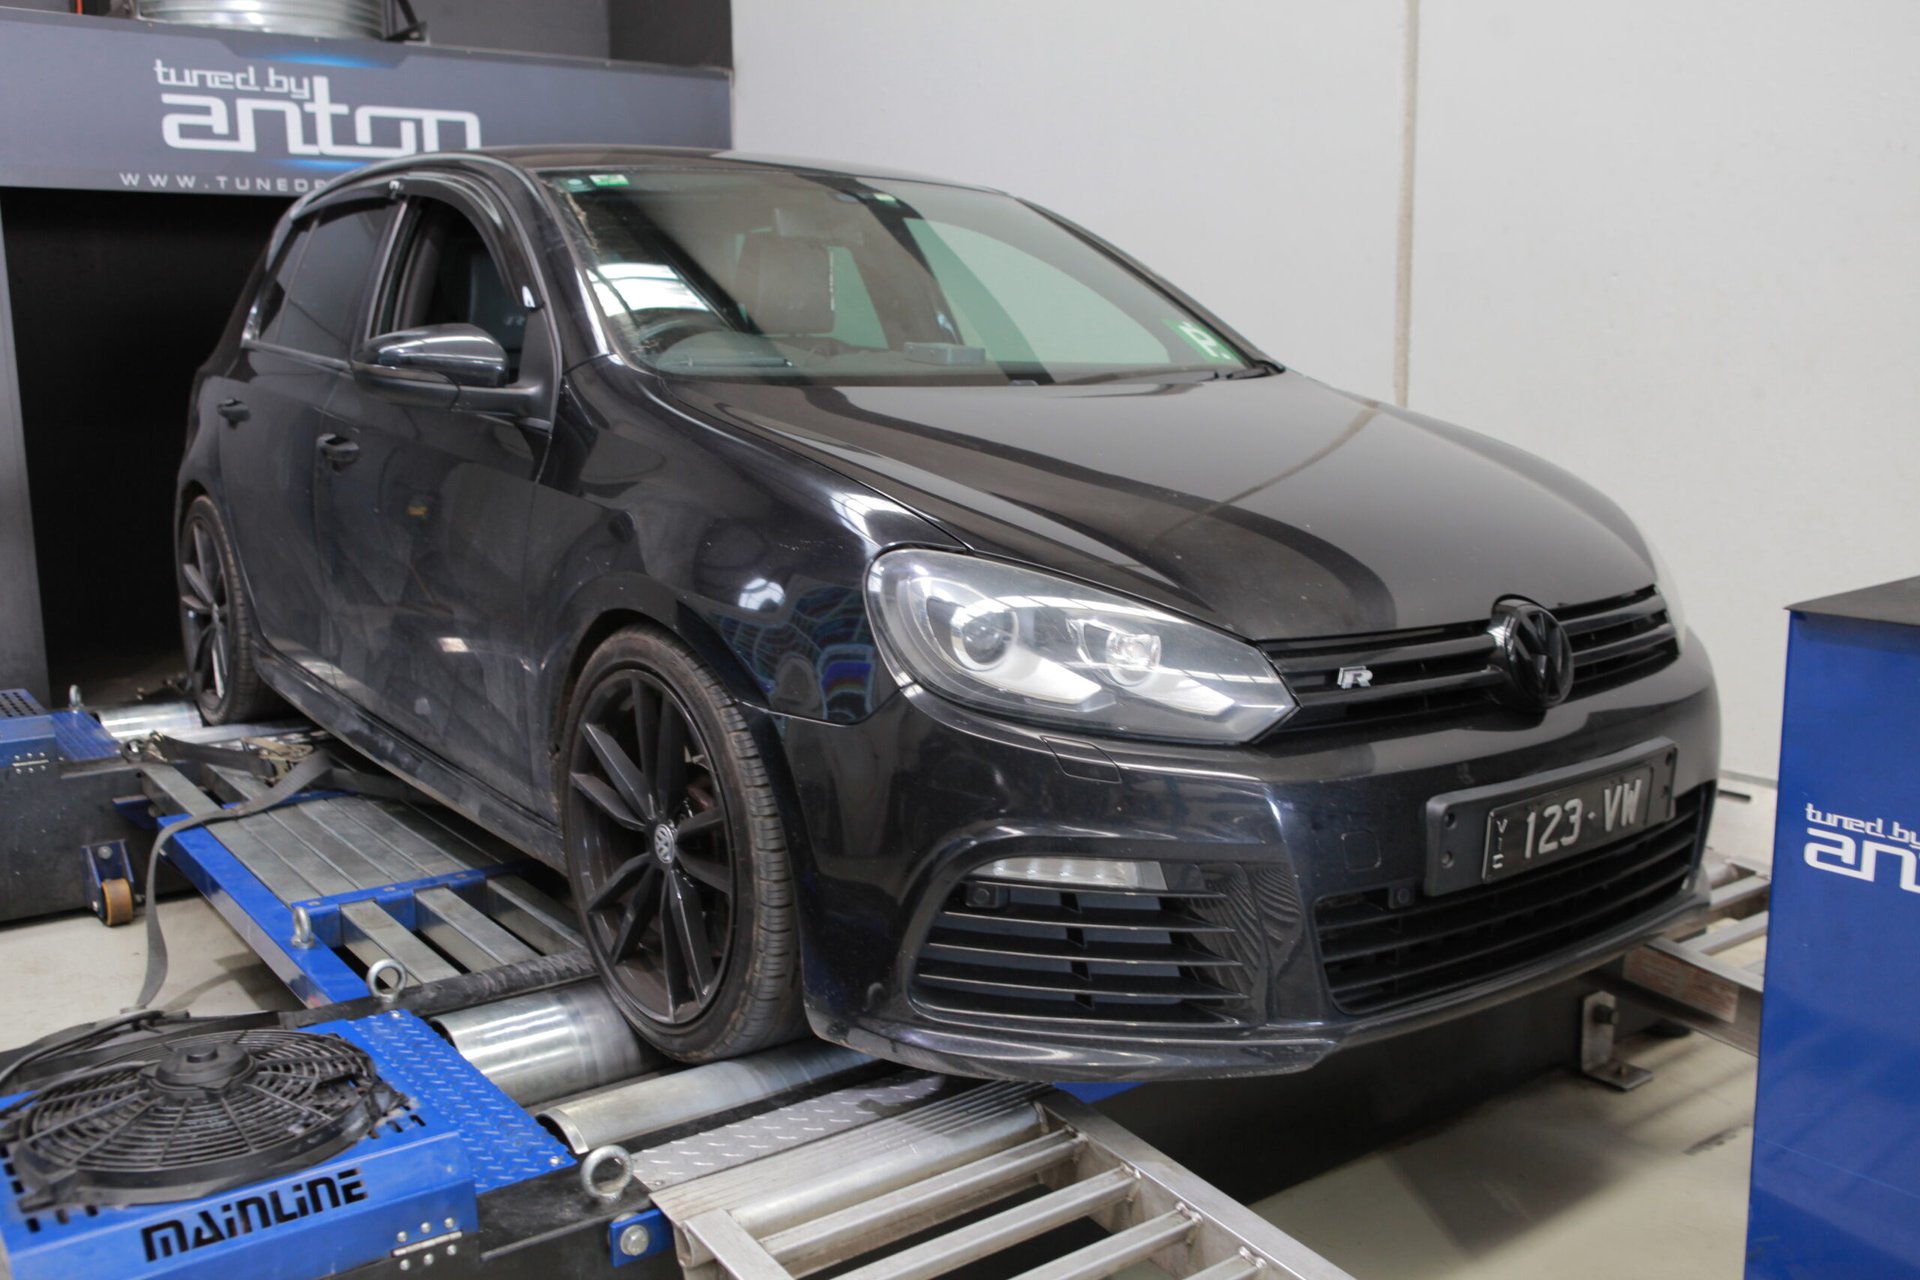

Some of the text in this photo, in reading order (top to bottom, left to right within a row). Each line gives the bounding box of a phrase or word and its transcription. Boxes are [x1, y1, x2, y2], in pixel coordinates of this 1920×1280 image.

[154, 59, 310, 99] tuned by
[161, 75, 482, 158] anton
[1337, 665, 1373, 689] R
[1805, 802, 1886, 838] tuned
[1804, 827, 1920, 894] an
